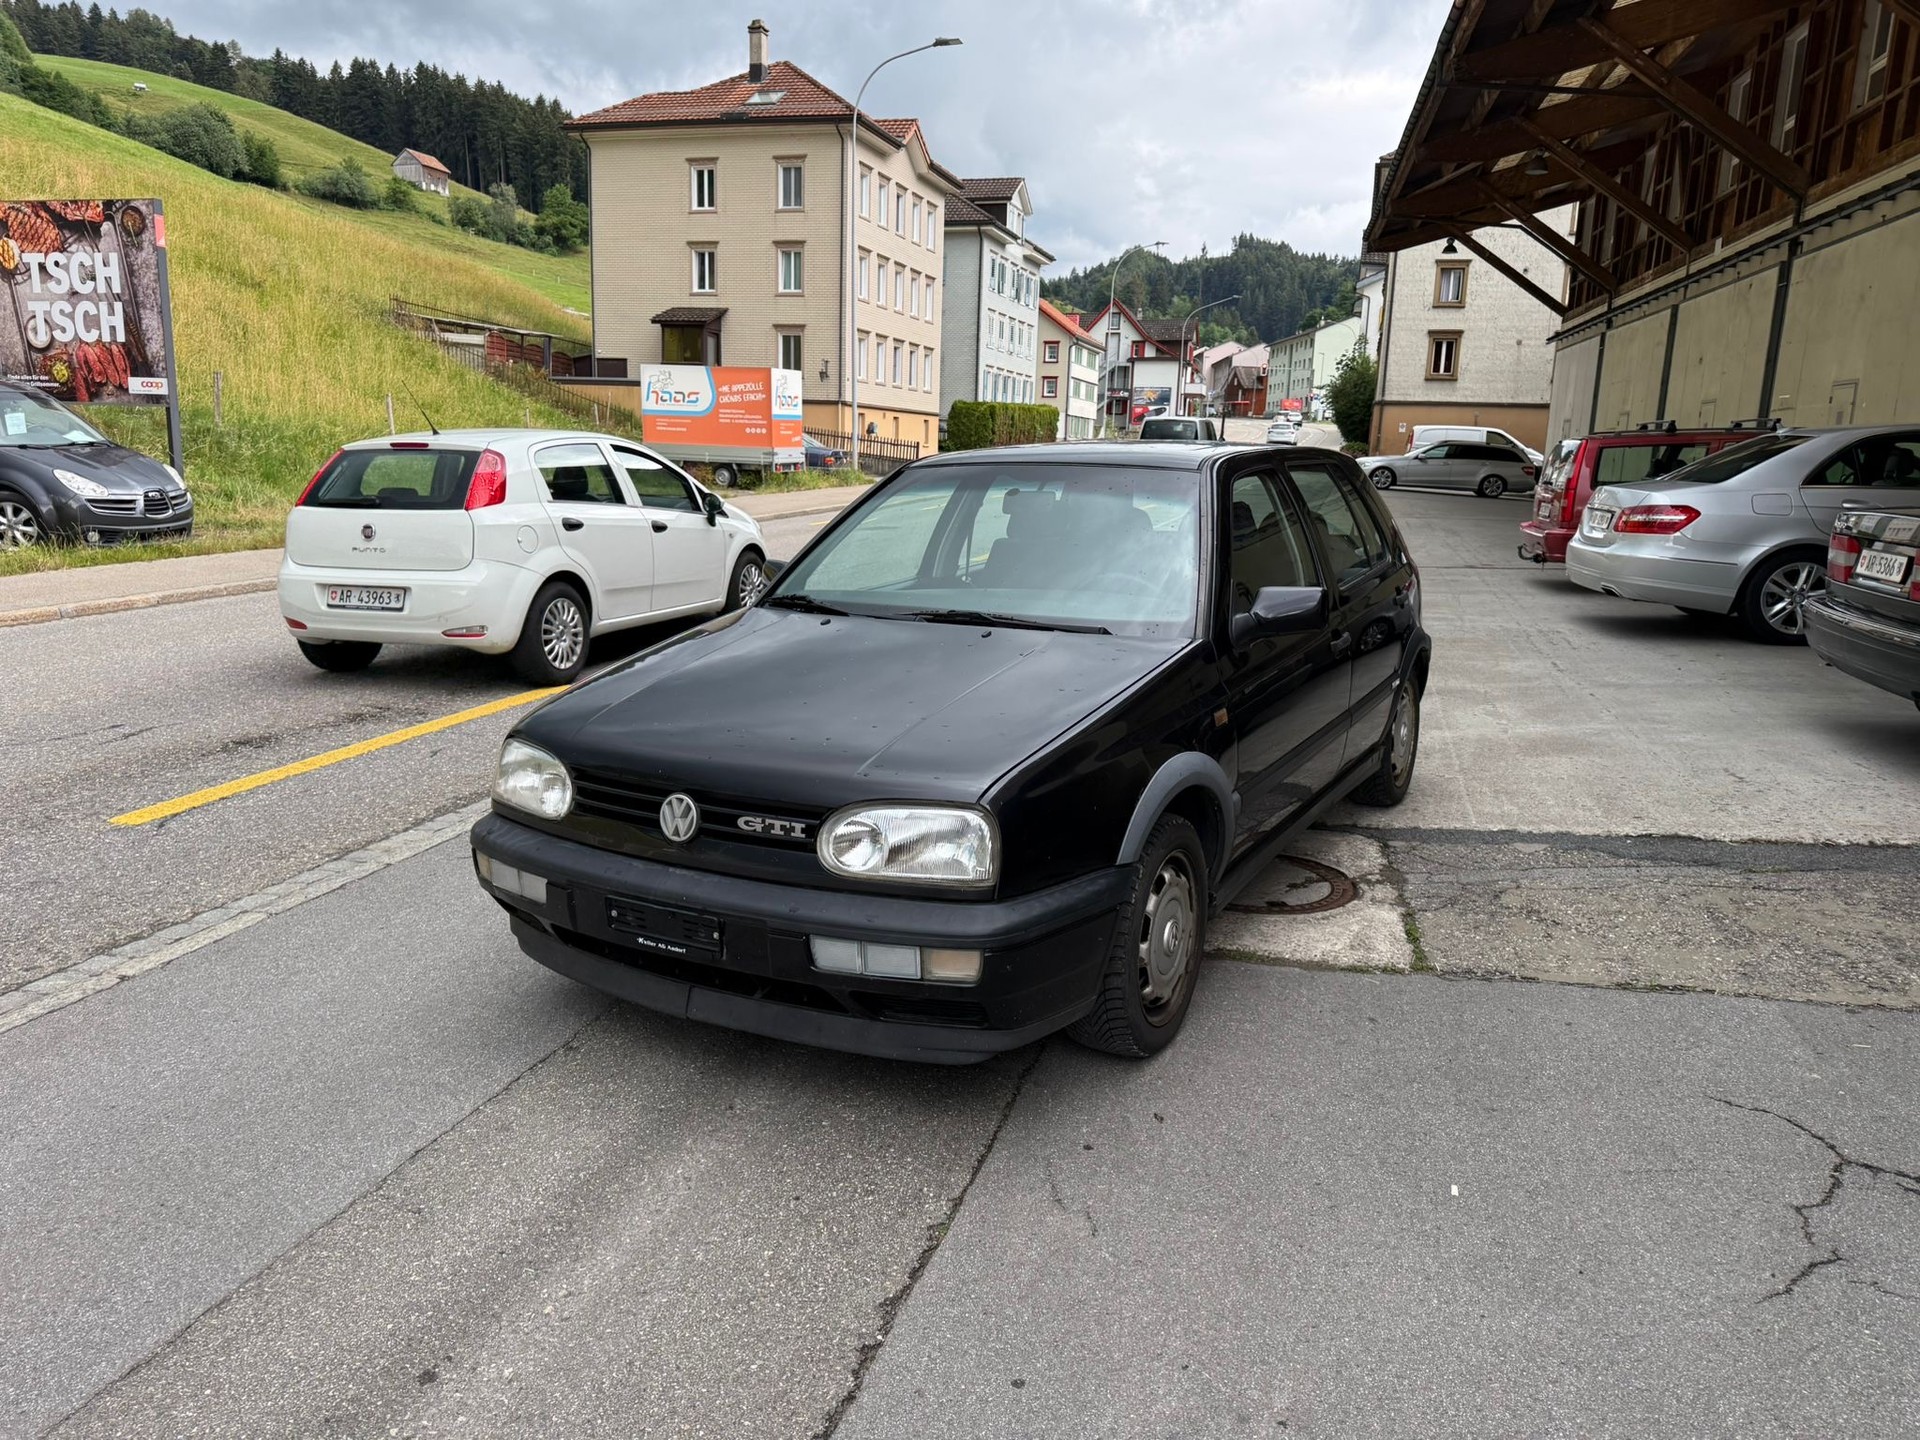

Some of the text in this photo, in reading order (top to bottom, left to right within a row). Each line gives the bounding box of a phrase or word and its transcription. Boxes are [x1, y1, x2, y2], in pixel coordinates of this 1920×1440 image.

[22, 252, 121, 294] TSCH
[28, 300, 126, 343] TSCH
[141, 380, 163, 390] coop
[646, 380, 700, 406] haas
[736, 816, 806, 839] GTI
